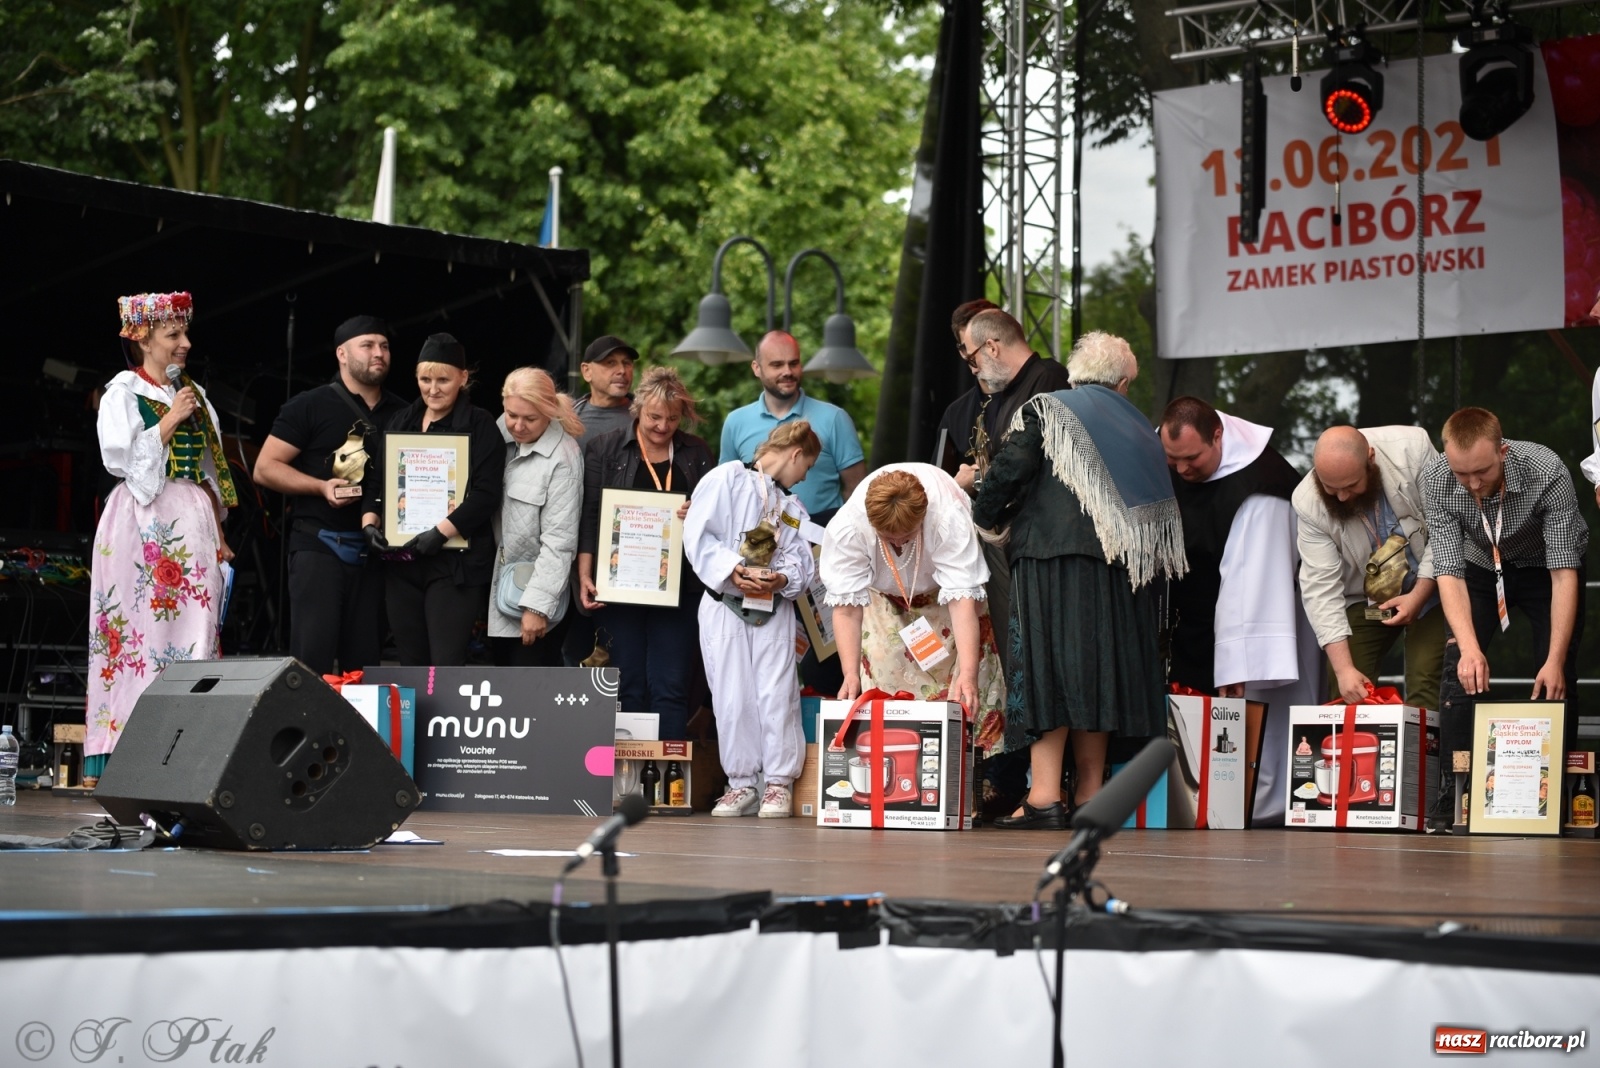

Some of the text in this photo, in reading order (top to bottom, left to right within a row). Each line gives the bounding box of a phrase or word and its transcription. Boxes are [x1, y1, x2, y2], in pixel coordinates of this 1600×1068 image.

[1200, 121, 1501, 197] 1.06.2021
[1227, 184, 1486, 257] RACIBÓRZ
[1227, 246, 1486, 292] ZAMEK PIASTOWSKI
[427, 716, 530, 739] munu
[1211, 706, 1240, 721] Qilive
[460, 746, 496, 754] Voucher
